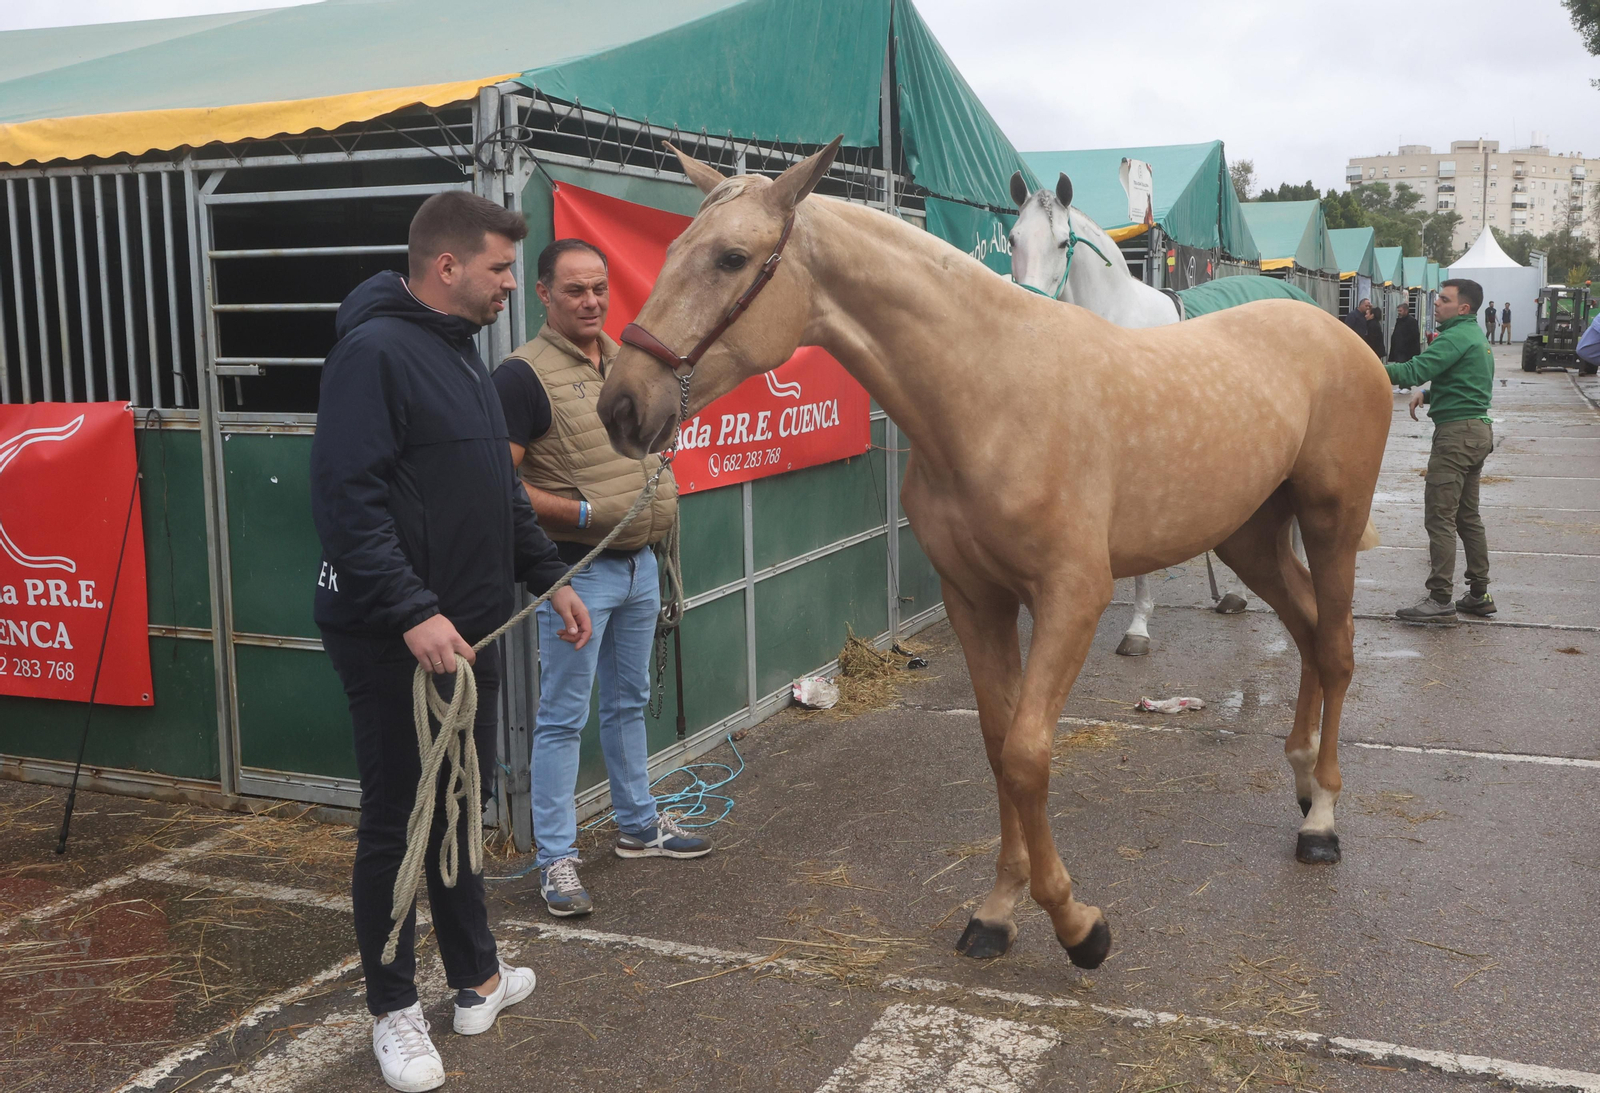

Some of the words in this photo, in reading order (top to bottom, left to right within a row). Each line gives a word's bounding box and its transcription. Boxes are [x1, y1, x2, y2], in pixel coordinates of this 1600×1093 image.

[716, 411, 772, 446] P.R.E.
[779, 399, 840, 438] CUENCA
[723, 455, 743, 472] 682
[744, 451, 762, 469] 283
[763, 447, 782, 466] 768
[0, 585, 19, 605] a
[24, 579, 103, 609] P.R.E.
[0, 619, 73, 649] ENCA
[12, 658, 41, 678] 283
[46, 661, 75, 681] 768
